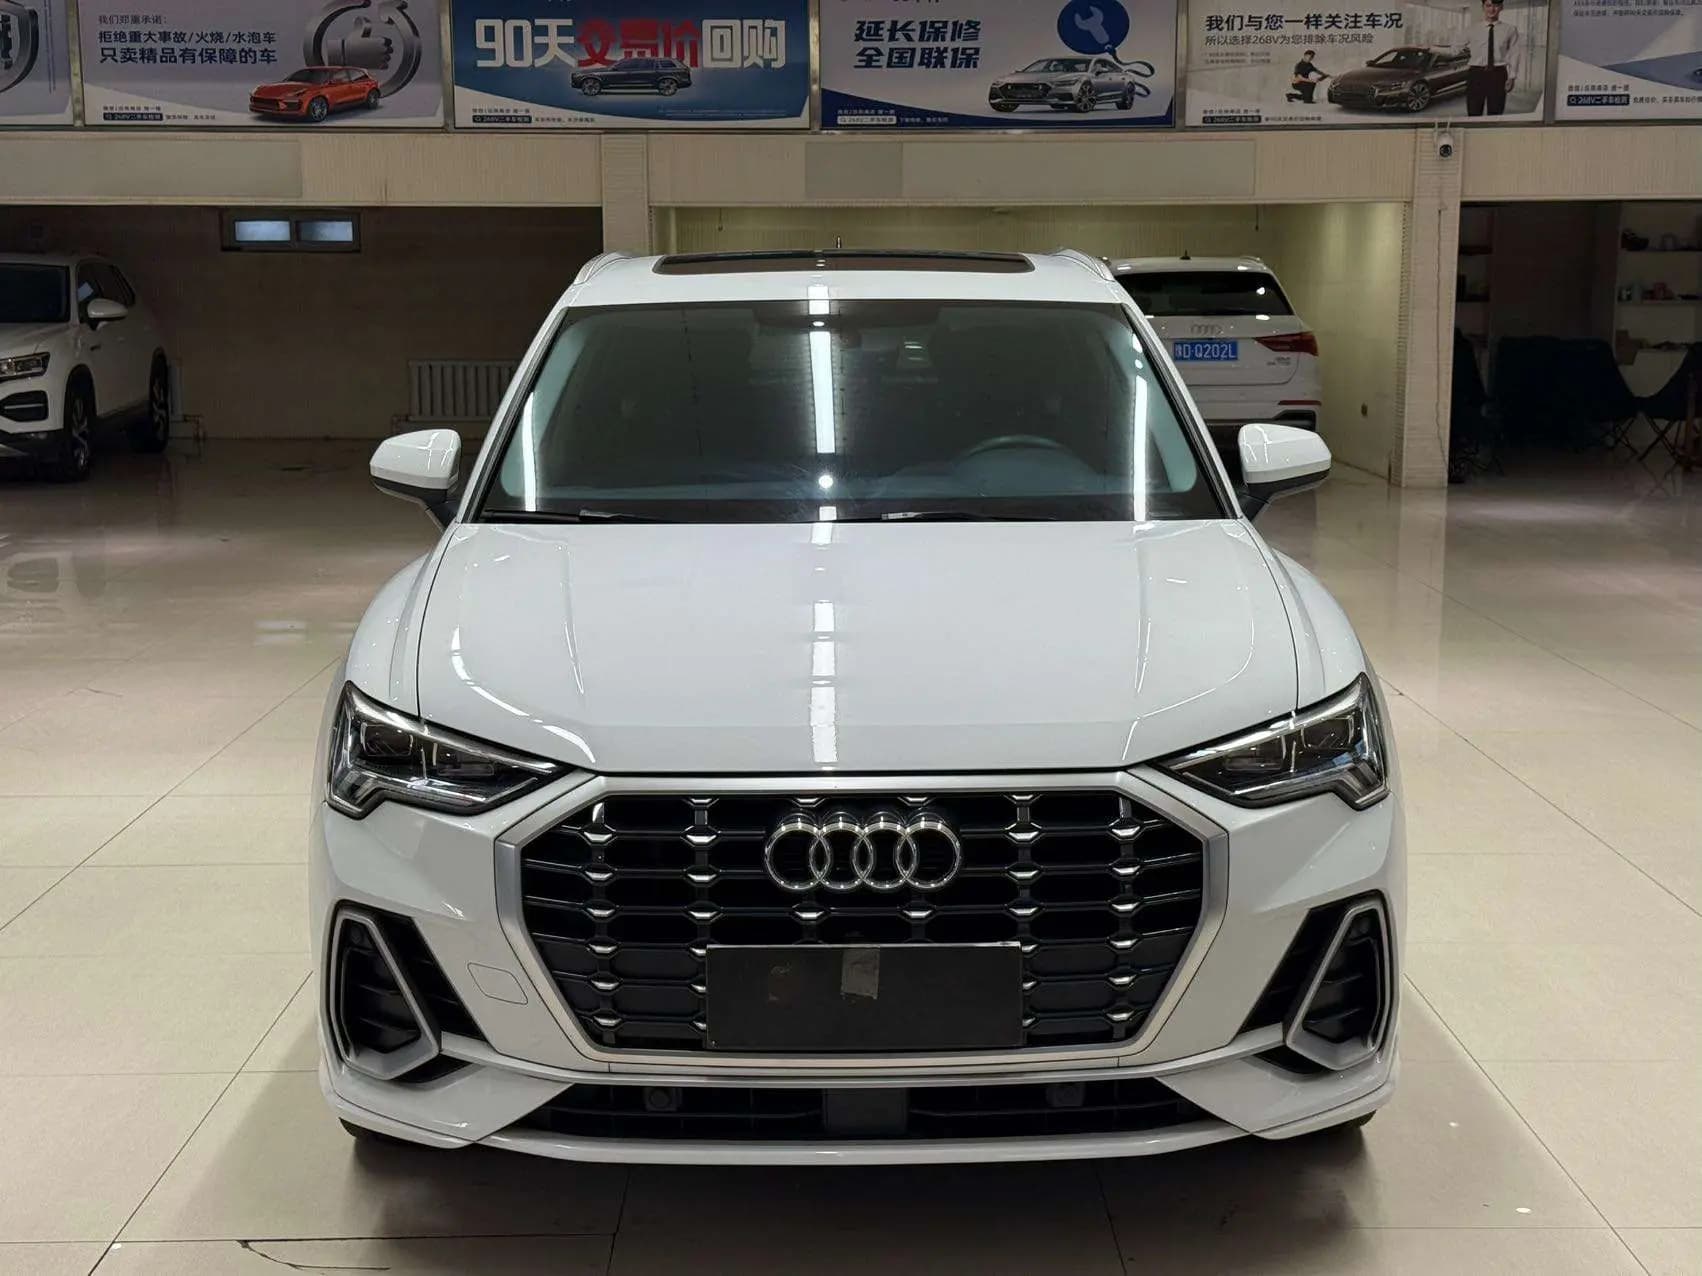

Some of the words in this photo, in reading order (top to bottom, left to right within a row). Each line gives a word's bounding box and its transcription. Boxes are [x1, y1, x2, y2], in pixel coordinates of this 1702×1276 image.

[854, 19, 982, 42] 延长保修
[1205, 12, 1404, 32] 我们与您一样关注车况
[98, 30, 277, 44] 拒绝重大事故/火烧/水泡车
[1204, 33, 1375, 46] 所以选择268V为您排除车况风险
[99, 47, 278, 64] 只卖精品有保障的车
[853, 46, 981, 69] 全国联保
